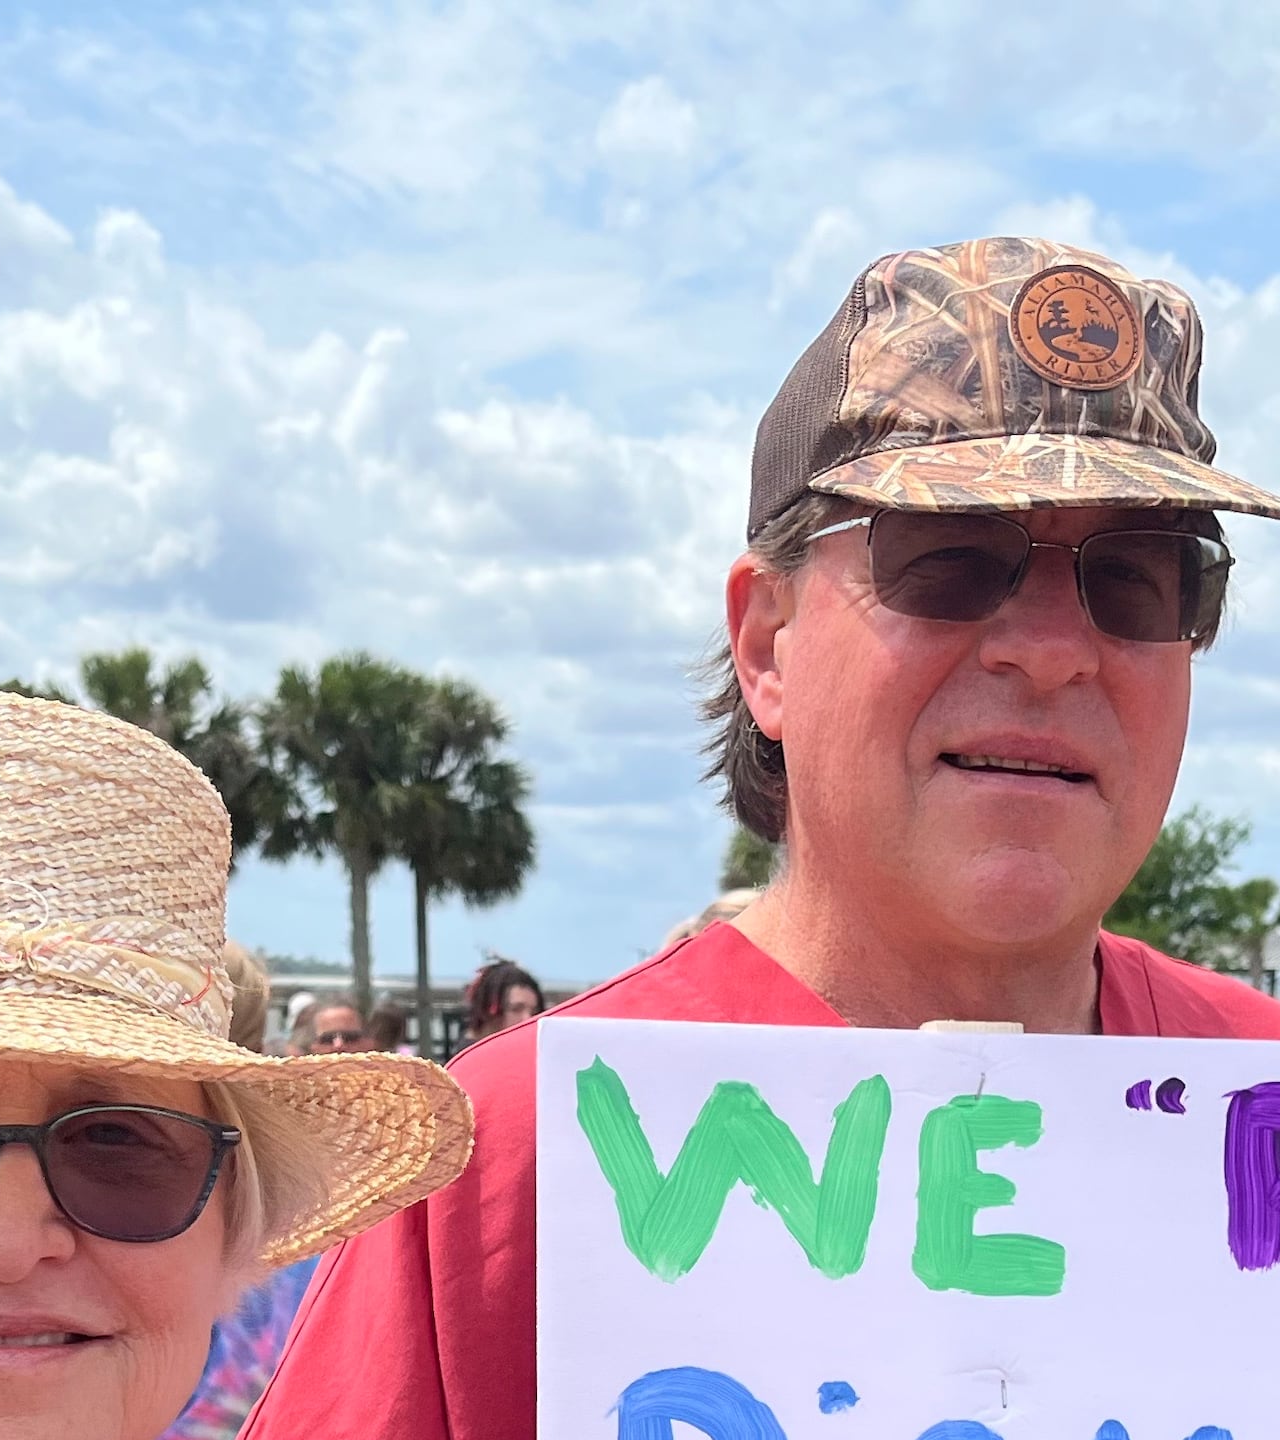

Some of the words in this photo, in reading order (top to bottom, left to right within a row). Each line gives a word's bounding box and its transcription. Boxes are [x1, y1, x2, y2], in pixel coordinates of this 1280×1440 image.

[1022, 273, 1126, 322] ALTAMAHA
[1045, 355, 1121, 378] RIVER
[576, 1055, 1065, 1297] WE
